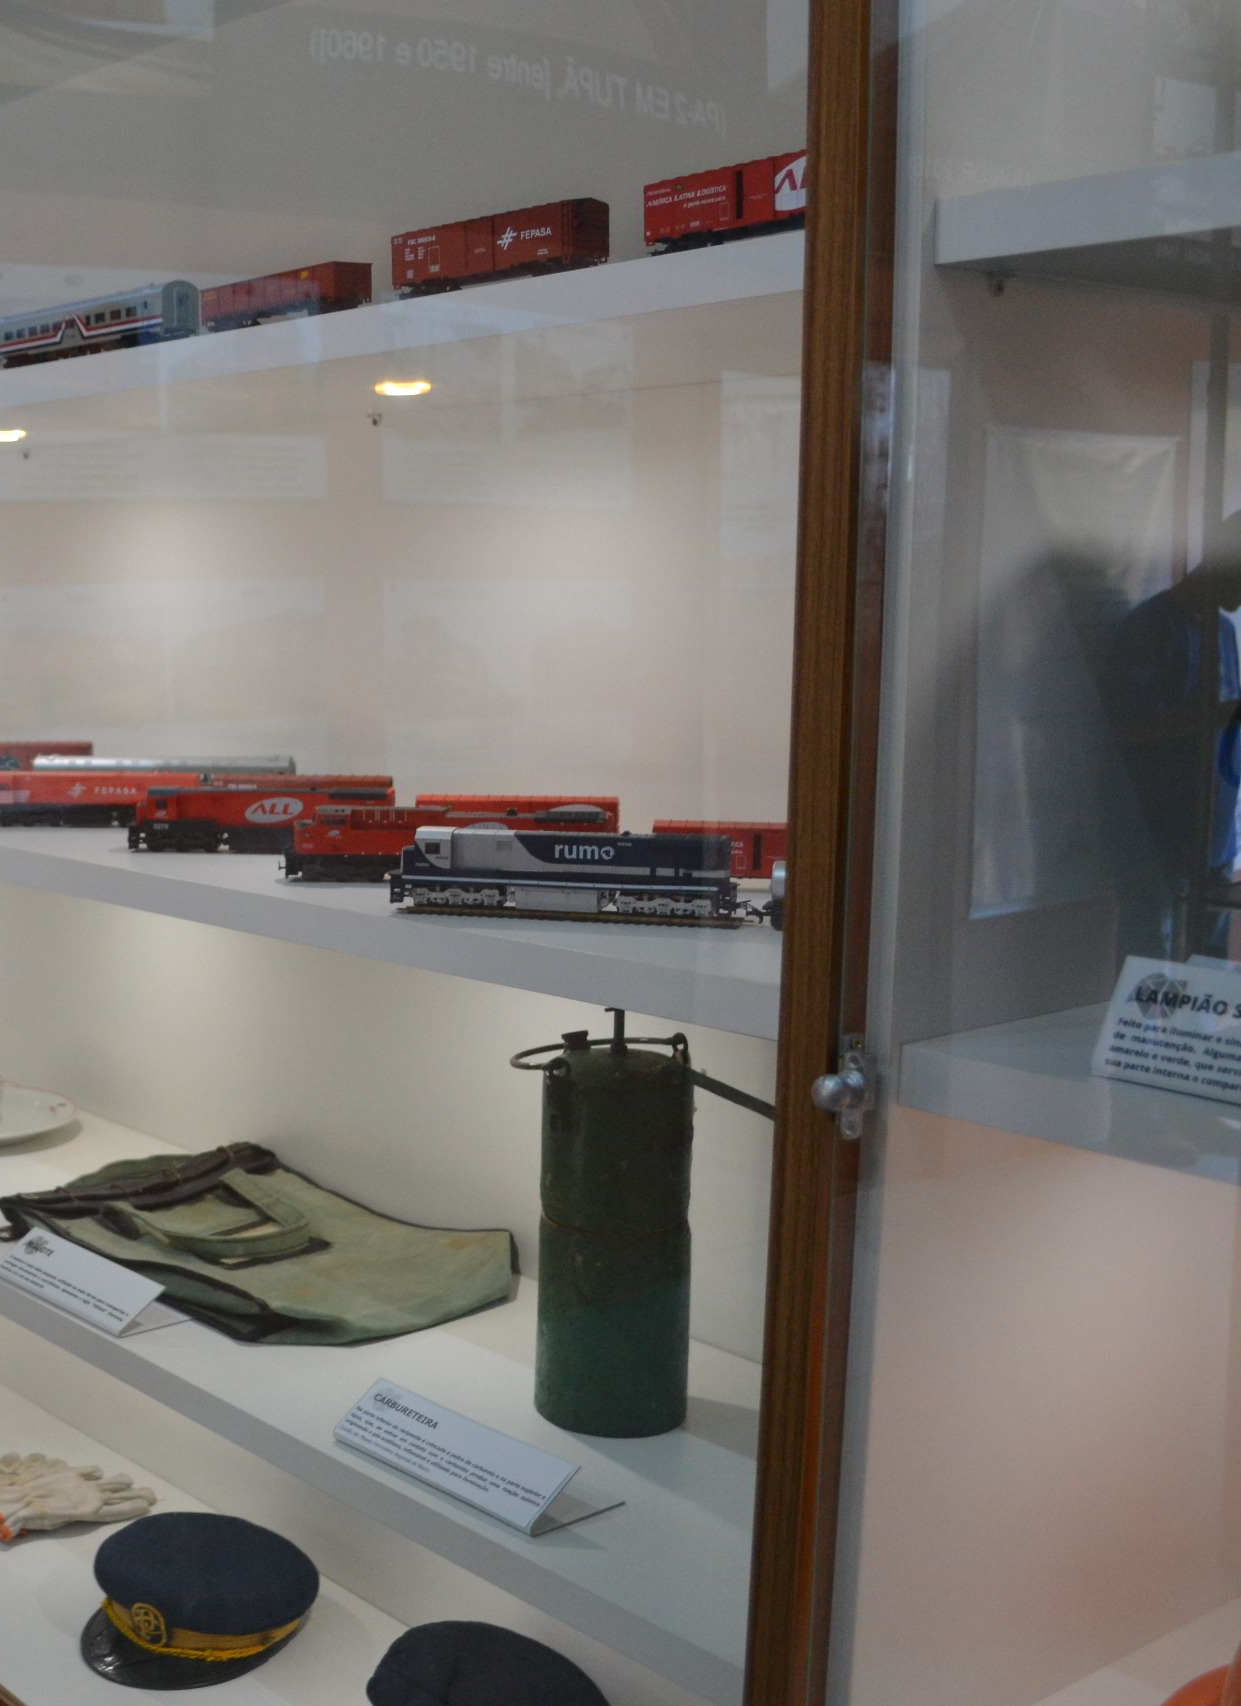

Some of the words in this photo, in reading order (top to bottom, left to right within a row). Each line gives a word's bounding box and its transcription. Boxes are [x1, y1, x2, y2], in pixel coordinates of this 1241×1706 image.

[520, 226, 553, 241] FEPASA
[94, 786, 137, 795] FEPASA
[248, 802, 297, 816] ALL
[554, 843, 615, 860] rumo
[1135, 987, 1229, 1016] LAMPIÃO
[1117, 1017, 1142, 1030] Feito
[1144, 1023, 1167, 1035] para
[1114, 1030, 1126, 1040] de
[1104, 1058, 1121, 1068] sua
[1123, 1062, 1151, 1074] parte
[1152, 1064, 1190, 1081] interna
[374, 1393, 439, 1430] CARBURETEIRA
